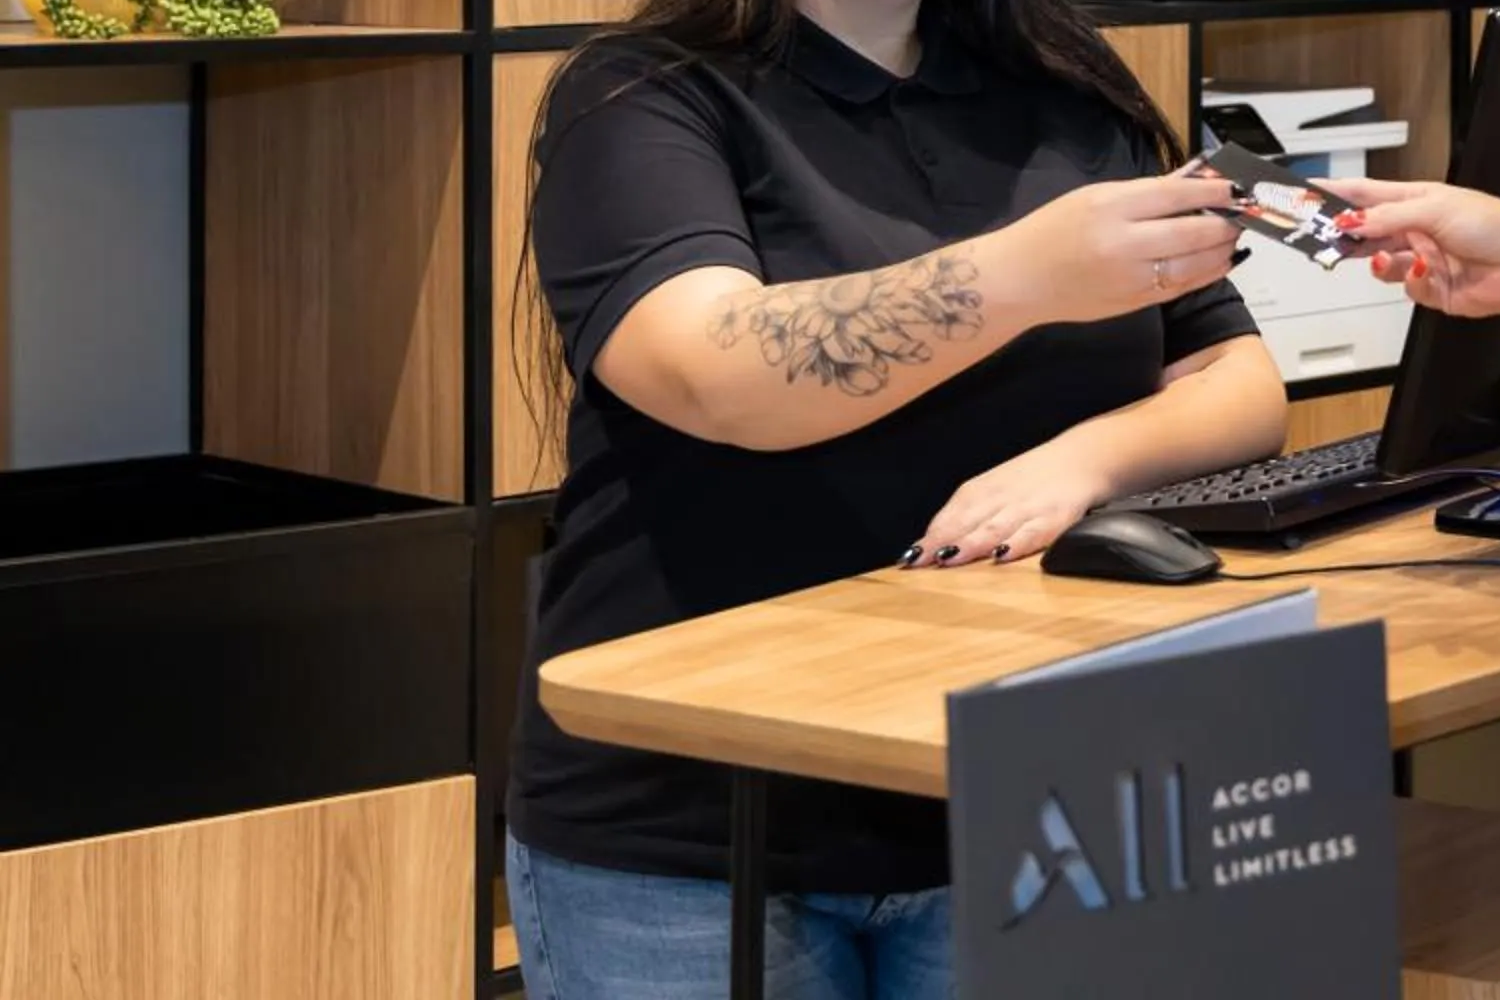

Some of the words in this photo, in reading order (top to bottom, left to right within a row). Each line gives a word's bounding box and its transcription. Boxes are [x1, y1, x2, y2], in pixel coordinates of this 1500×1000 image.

[1212, 769, 1312, 810] ACCOR
[1212, 814, 1275, 848] LIVE
[1214, 835, 1358, 886] LIMITLESS
